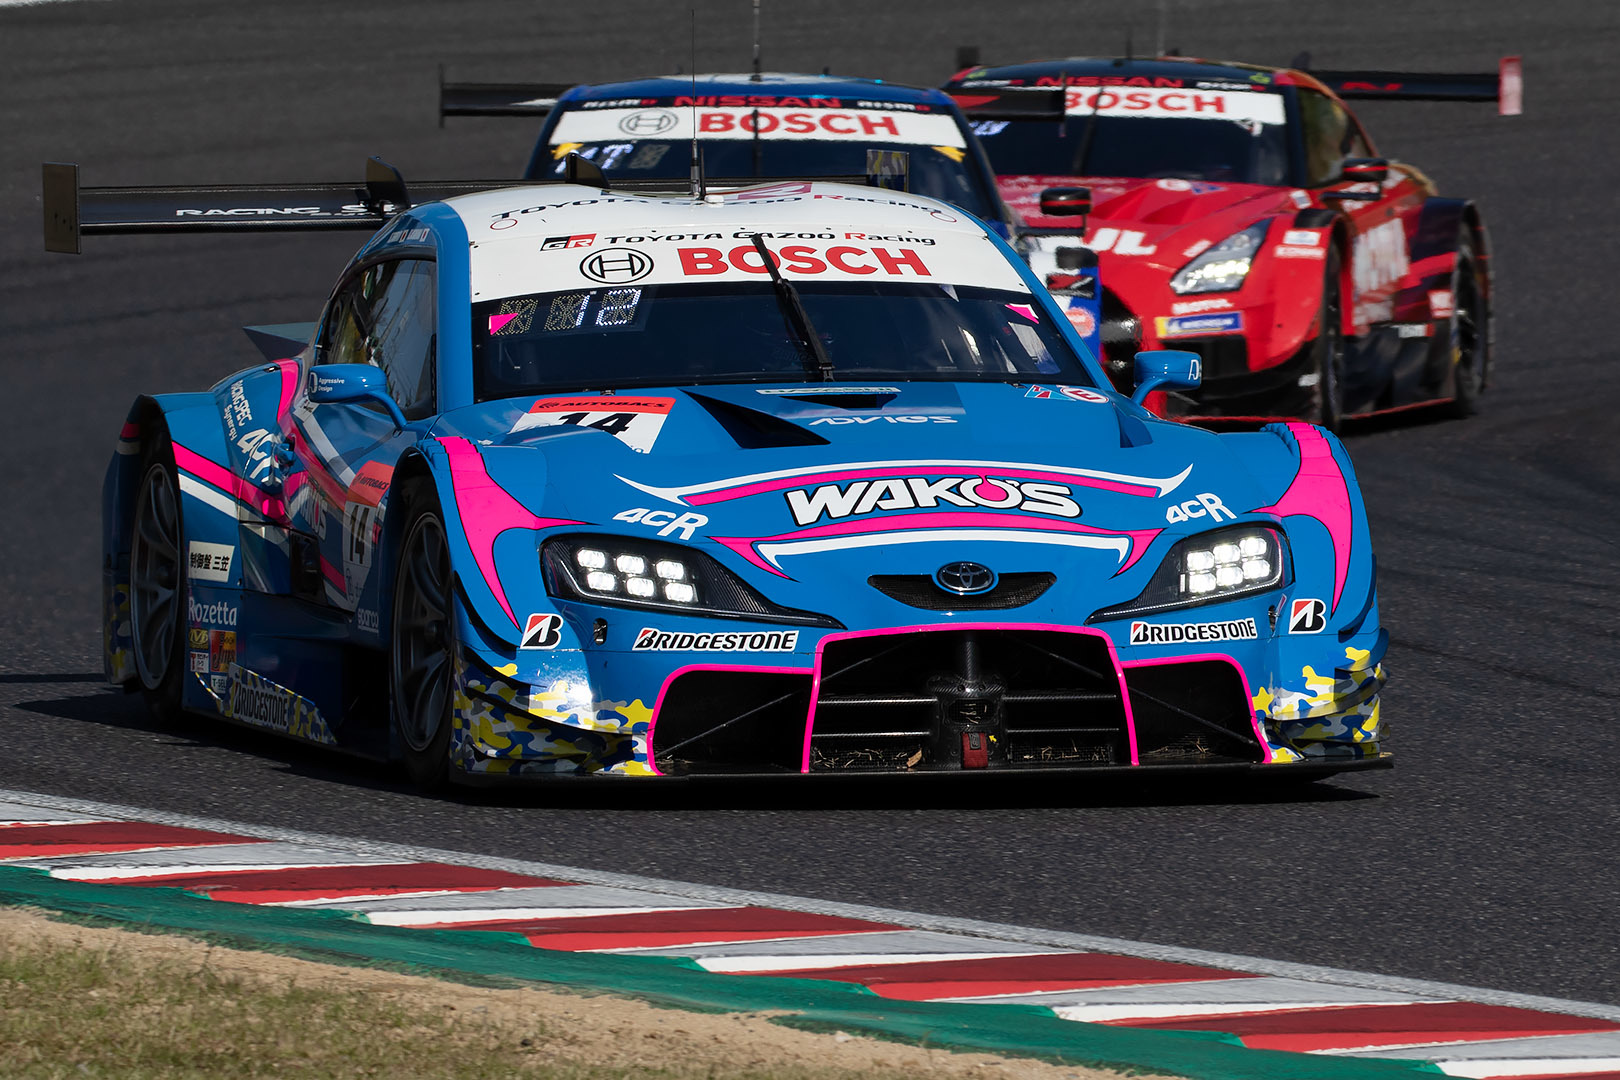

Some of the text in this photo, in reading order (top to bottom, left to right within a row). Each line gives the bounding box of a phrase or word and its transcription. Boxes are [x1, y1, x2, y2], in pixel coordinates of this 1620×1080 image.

[1036, 76, 1184, 88] NISSAN
[674, 96, 842, 107] NISSAN
[1065, 92, 1226, 114] BOSCH
[699, 112, 901, 136] BOSCH
[176, 206, 320, 216] RACING
[541, 235, 596, 250] GR
[605, 232, 723, 244] TOYOTA
[844, 232, 936, 246] Racing
[677, 245, 932, 276] BOSCH
[560, 401, 668, 409] AUTOBACS
[223, 404, 238, 441] Synergy
[1166, 492, 1238, 524] 4CR
[349, 504, 370, 565] 14
[612, 508, 709, 541] 4CR
[188, 596, 238, 627] Rozetta
[634, 628, 796, 651] BRIDGESTONE
[1132, 620, 1257, 644] BRIDGESTONE
[235, 681, 288, 727] BRIDGESTONE
